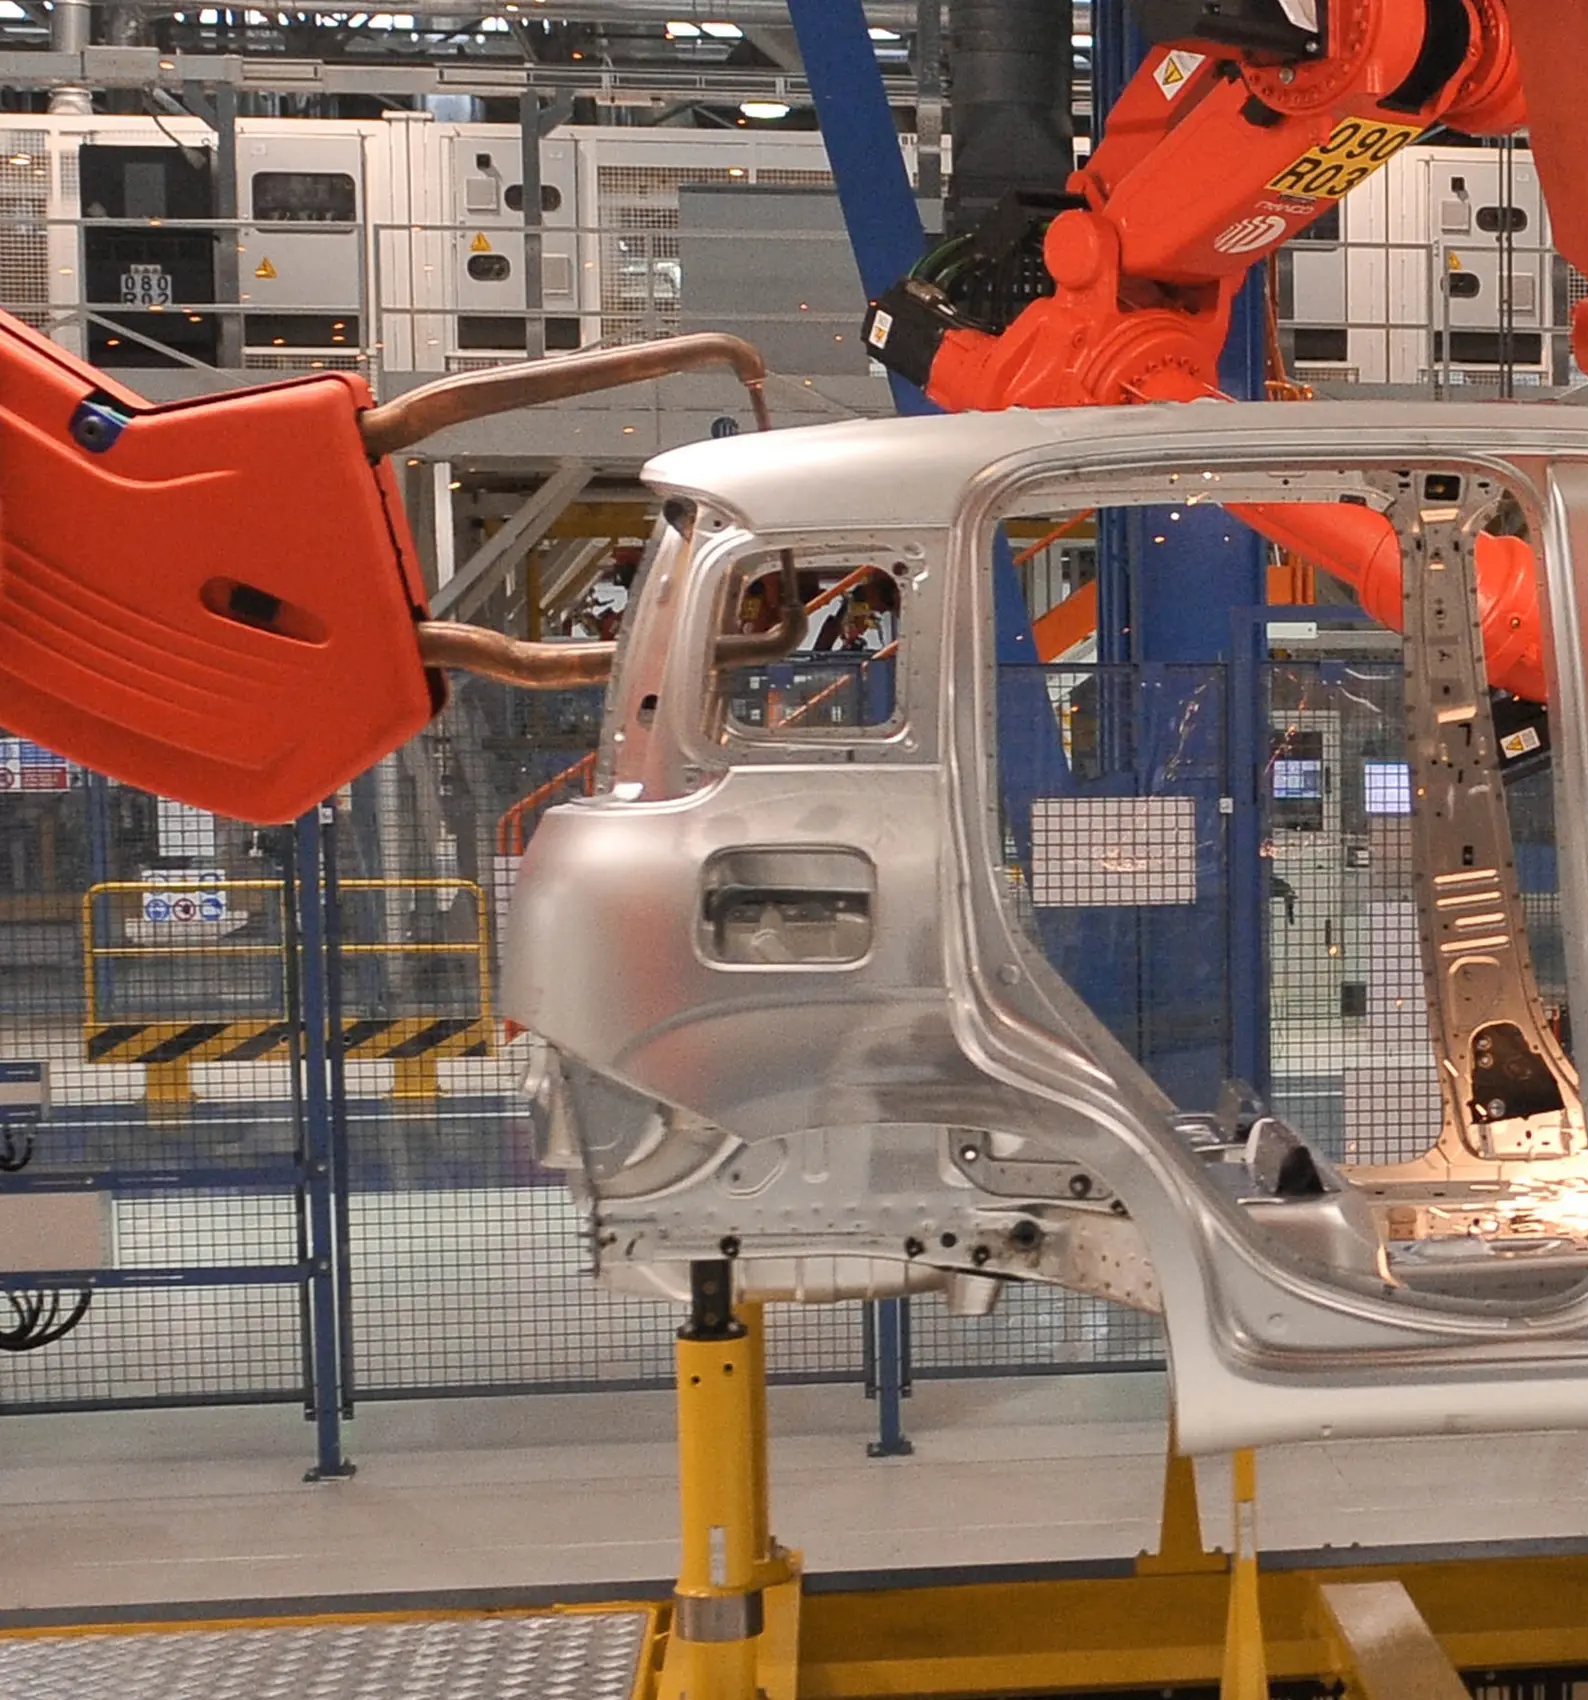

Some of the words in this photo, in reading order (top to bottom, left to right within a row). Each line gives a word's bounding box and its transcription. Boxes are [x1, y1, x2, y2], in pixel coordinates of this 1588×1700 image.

[1319, 122, 1412, 162] 090
[1271, 157, 1369, 195] R03
[125, 275, 168, 291] 080
